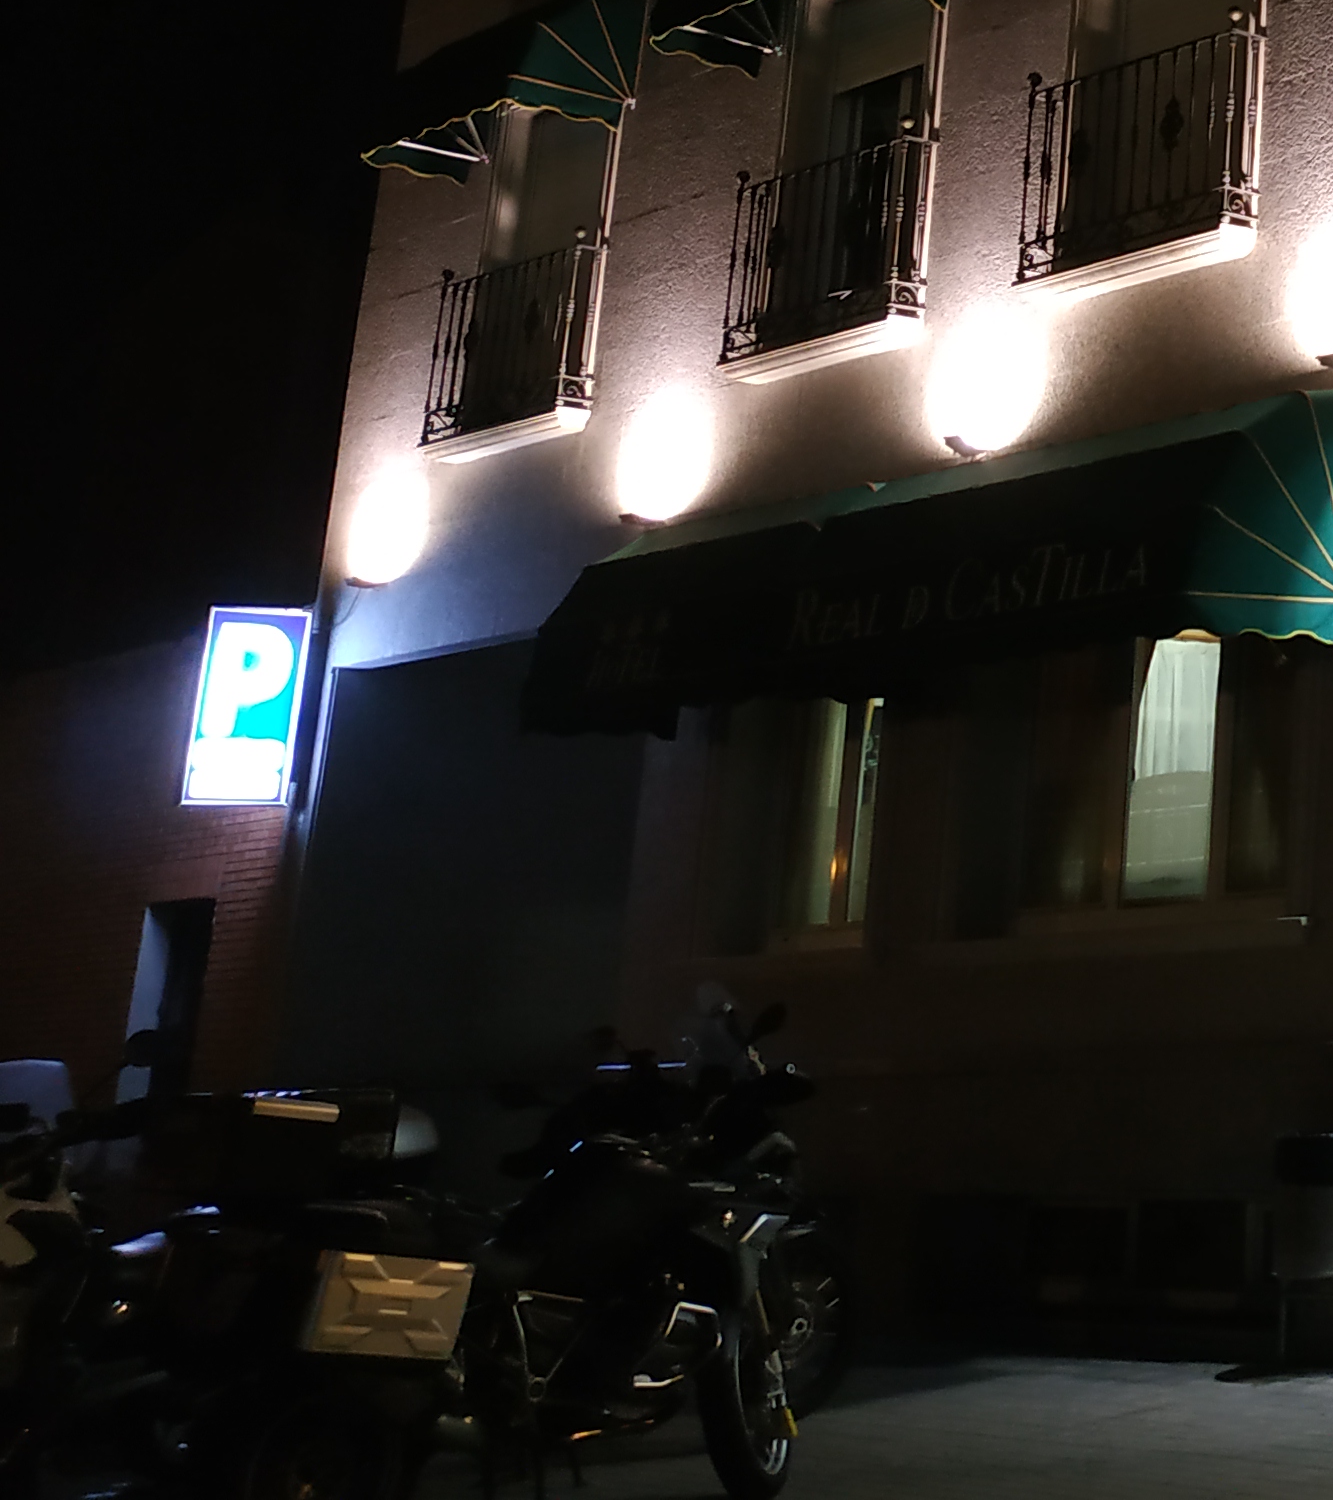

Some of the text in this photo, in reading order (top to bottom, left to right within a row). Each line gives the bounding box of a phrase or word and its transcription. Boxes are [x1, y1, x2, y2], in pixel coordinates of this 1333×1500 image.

[786, 585, 885, 652] REAL
[943, 541, 1151, 621] CASTILLA
[200, 621, 295, 738] P
